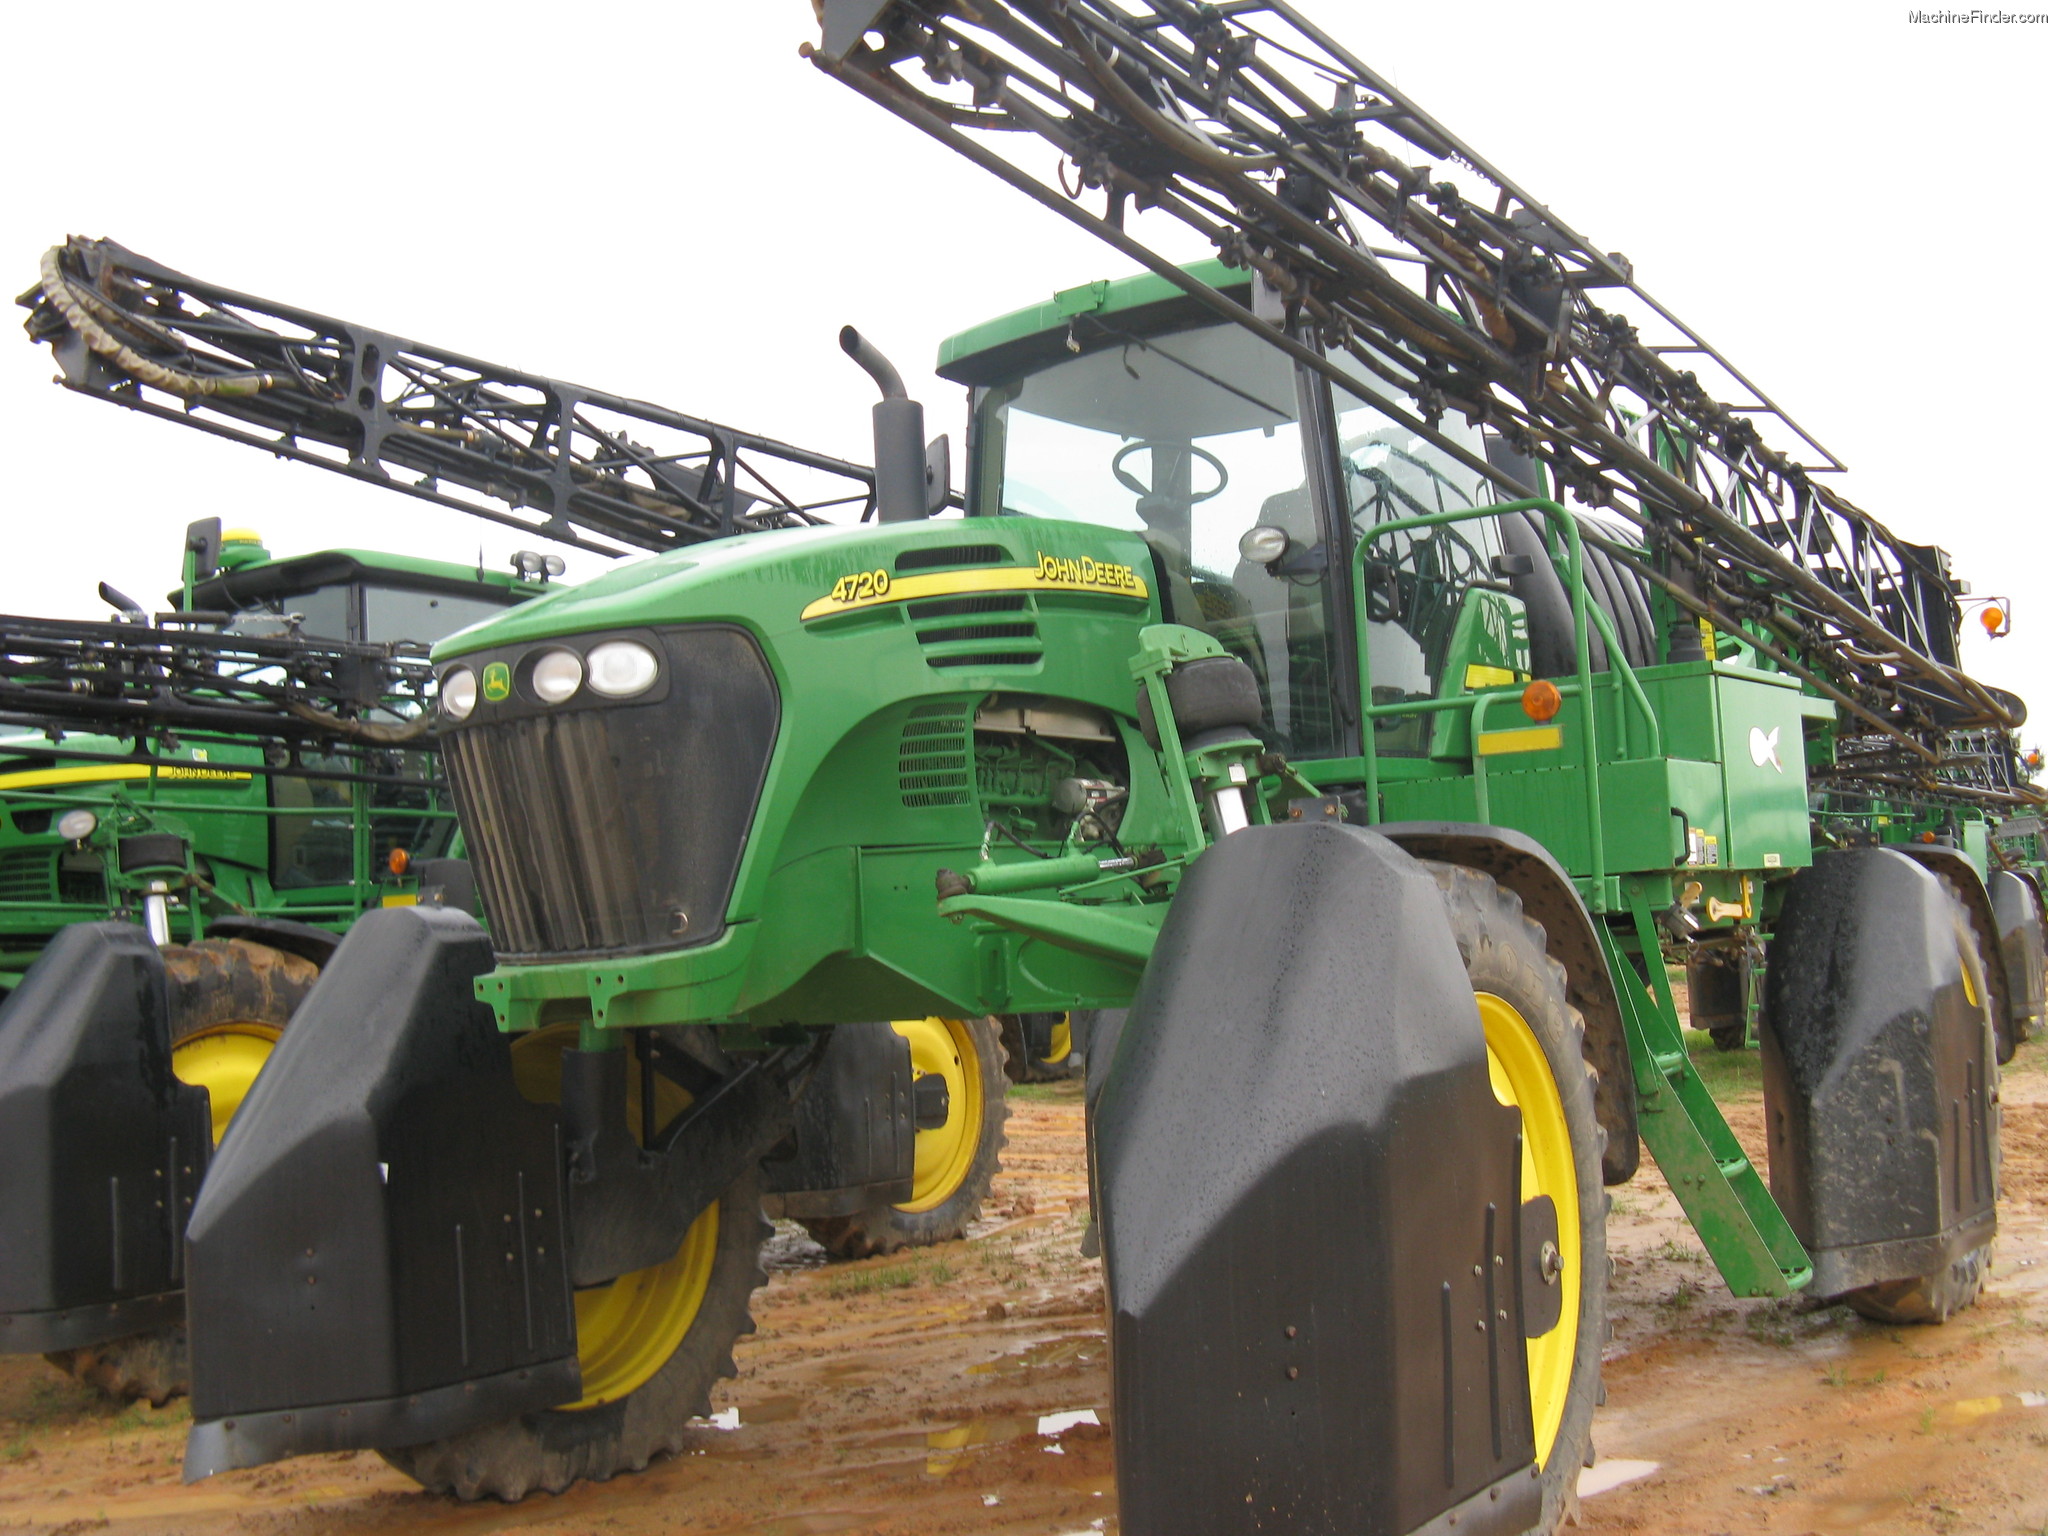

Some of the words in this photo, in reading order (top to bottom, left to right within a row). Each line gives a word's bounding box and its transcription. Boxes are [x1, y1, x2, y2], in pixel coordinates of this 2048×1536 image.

[831, 568, 890, 602] 4720
[1034, 550, 1082, 583] JOHN
[1080, 555, 1136, 589] DEERE
